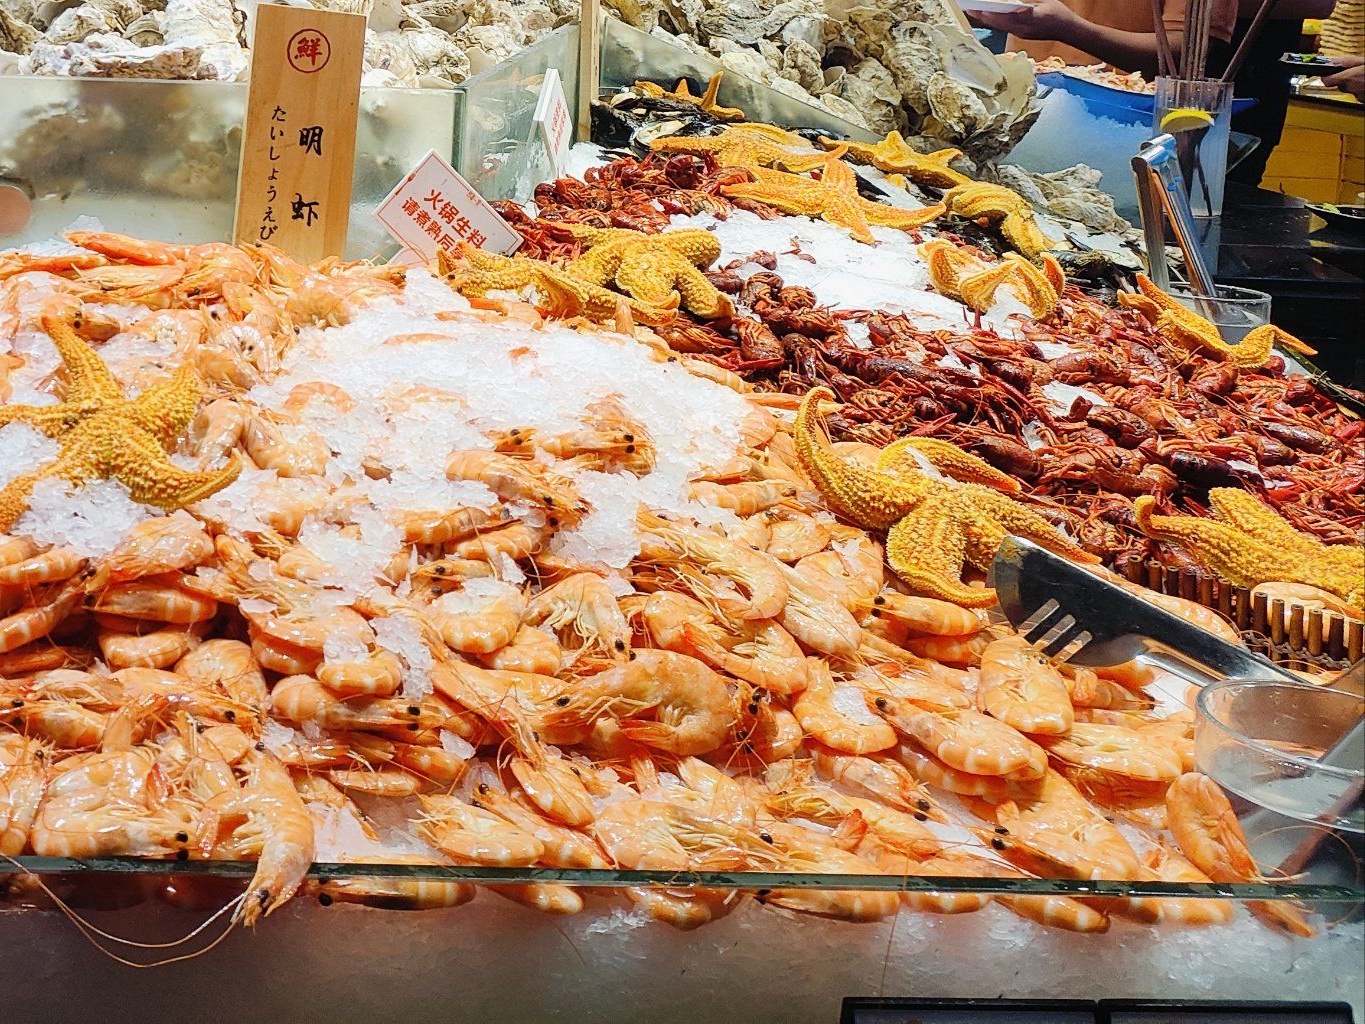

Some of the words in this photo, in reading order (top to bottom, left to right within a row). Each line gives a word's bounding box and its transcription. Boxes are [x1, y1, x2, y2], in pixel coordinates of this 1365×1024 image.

[294, 36, 323, 66] 鮮
[259, 105, 287, 240] たいしょうえび
[290, 125, 324, 227] 明虾
[423, 189, 488, 249] 火锅生料
